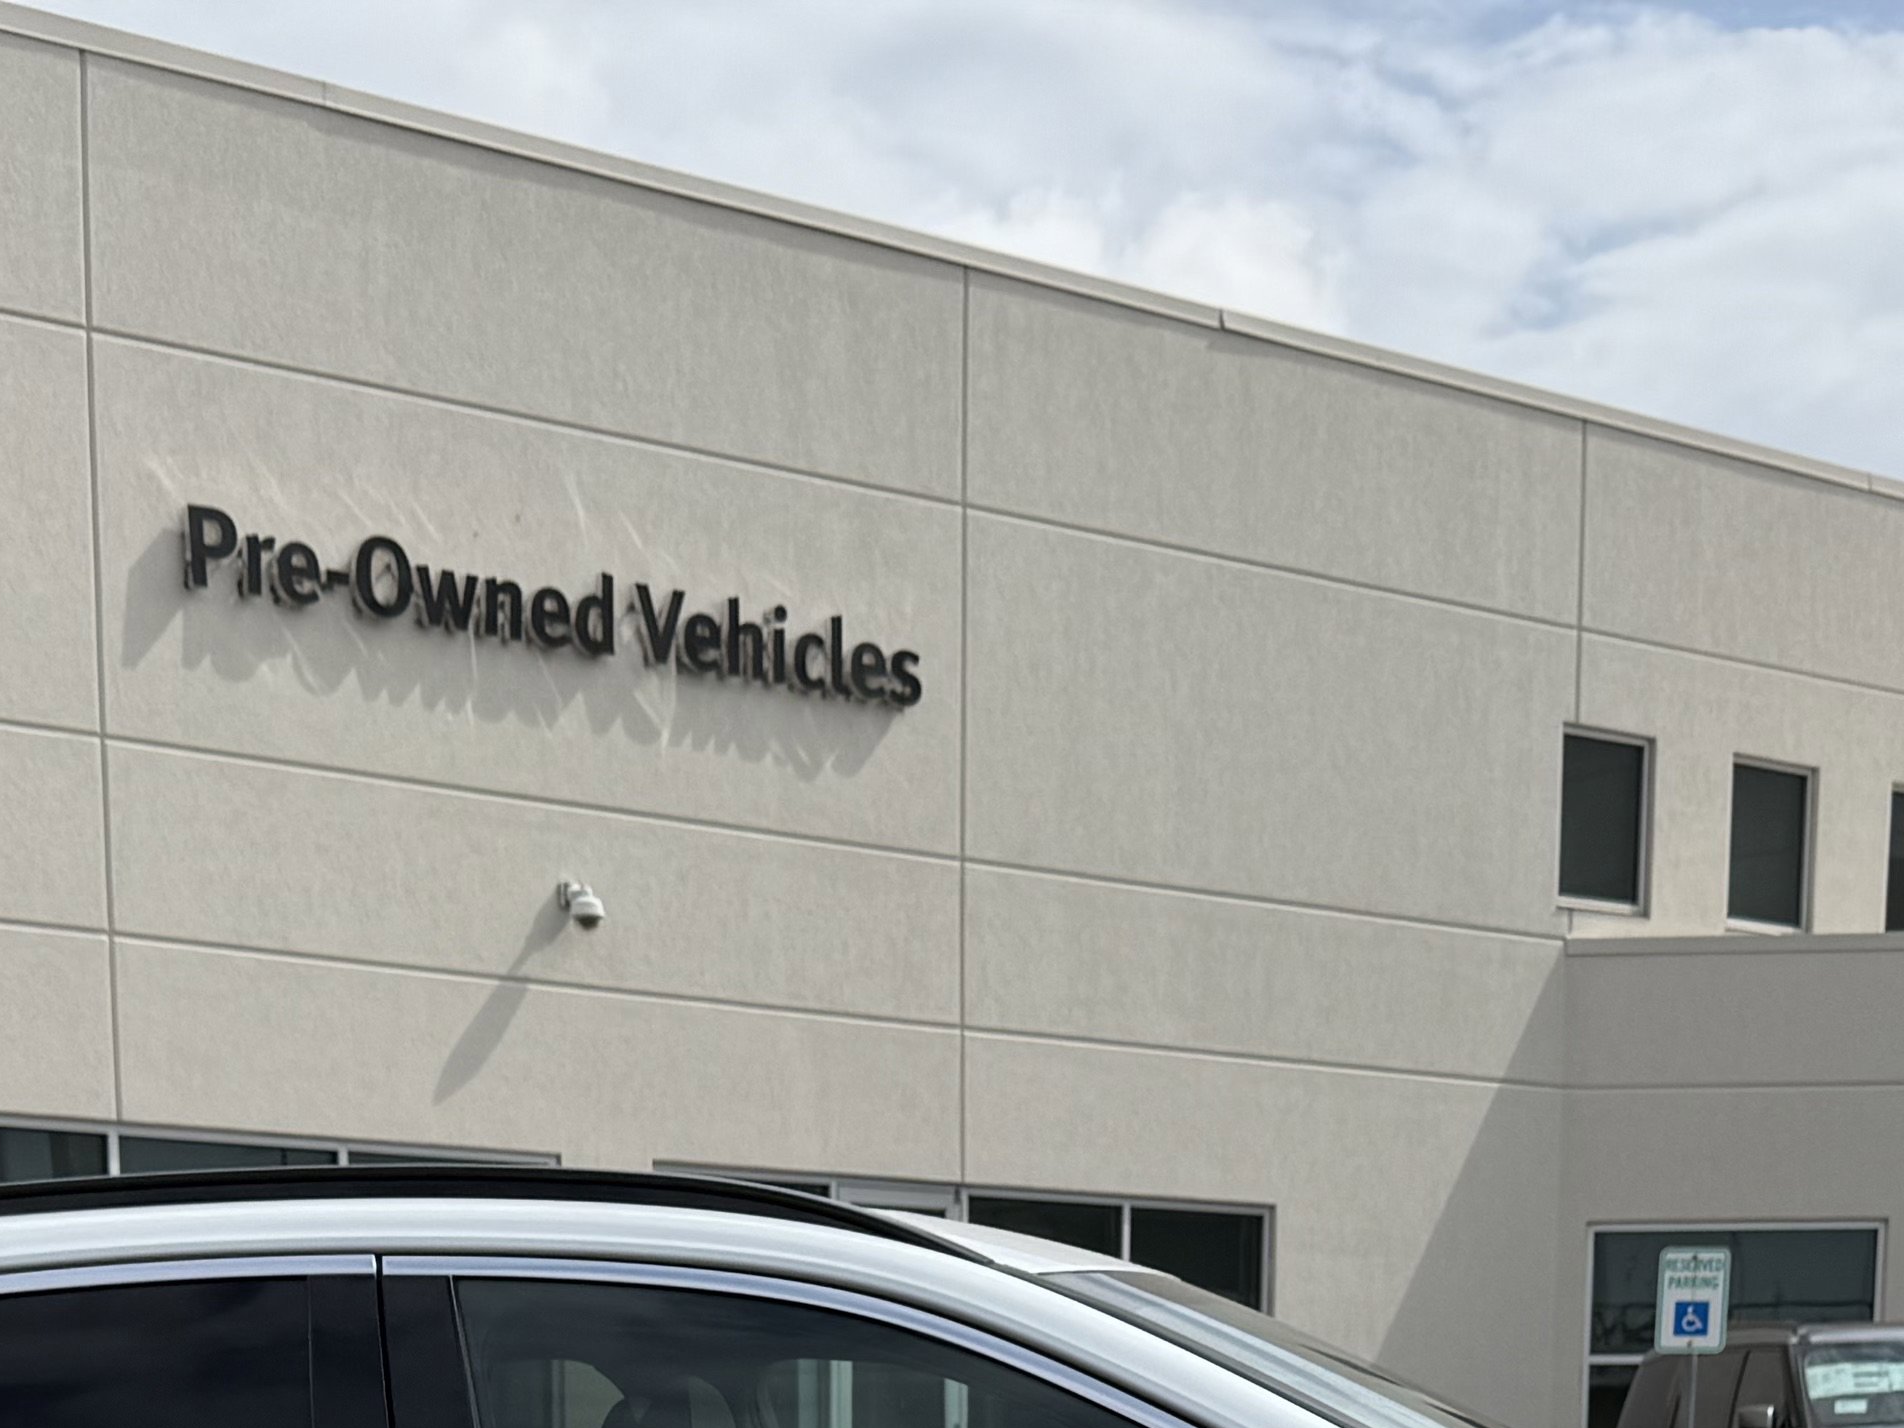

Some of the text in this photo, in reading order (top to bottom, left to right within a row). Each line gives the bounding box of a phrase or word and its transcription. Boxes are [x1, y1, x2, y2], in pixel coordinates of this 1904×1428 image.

[185, 503, 922, 707] Pre-Owned Vehicles
[1663, 1258, 1725, 1272] RESERVED
[1667, 1275, 1720, 1290] PARKING
